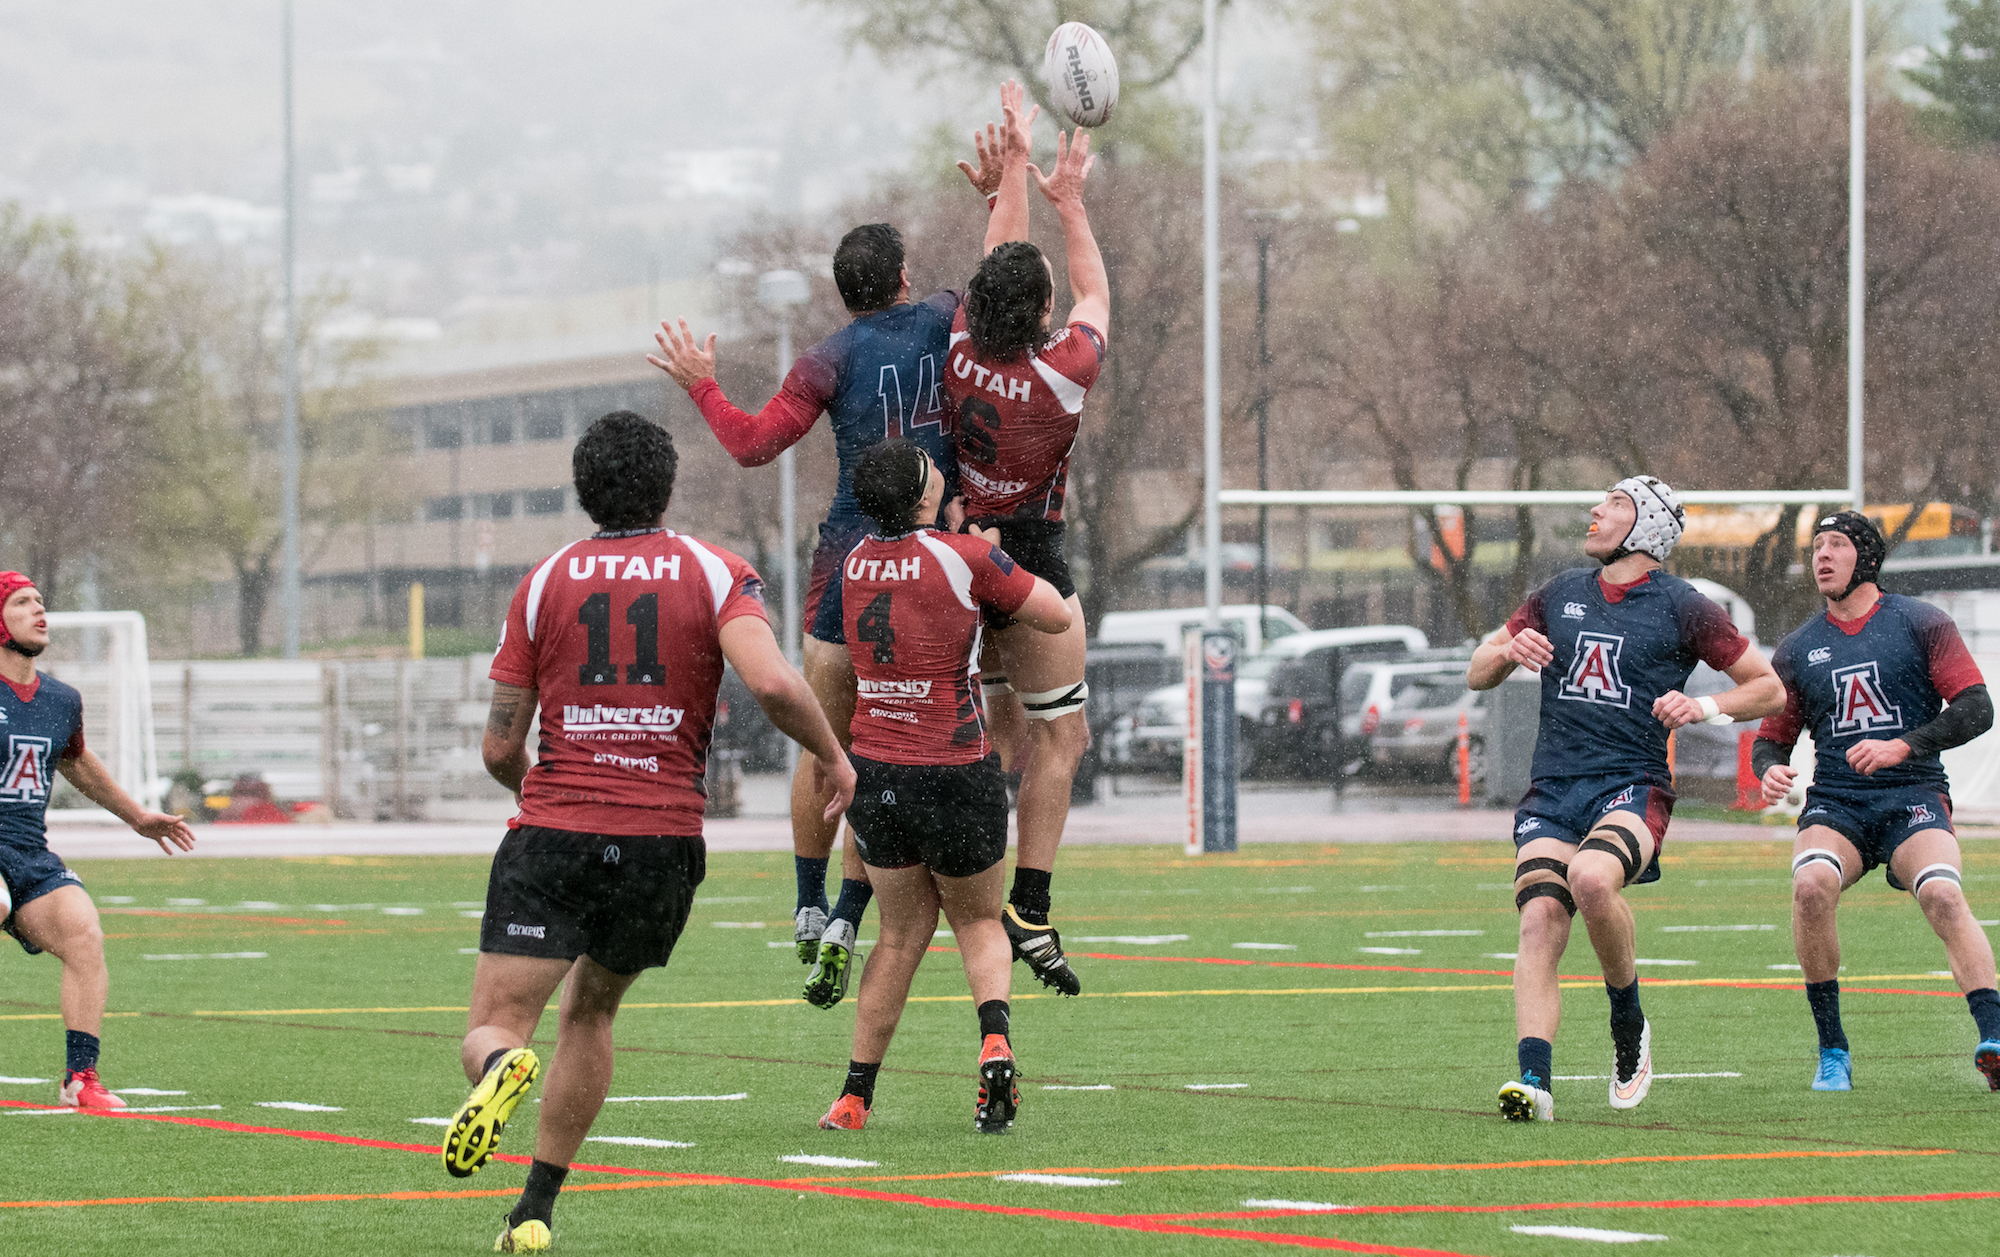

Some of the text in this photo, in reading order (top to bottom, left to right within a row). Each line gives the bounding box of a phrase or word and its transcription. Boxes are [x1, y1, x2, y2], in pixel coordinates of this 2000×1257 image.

[1065, 45, 1095, 111] RHINO
[878, 353, 951, 439] 14
[952, 351, 1032, 403] UTAH
[568, 554, 682, 581] UTAH
[846, 556, 921, 582] UTAH
[577, 592, 667, 686] 11
[856, 592, 896, 665] 4
[1557, 630, 1632, 710] A
[1830, 660, 1904, 738] A
[562, 703, 686, 733] University
[564, 732, 608, 741] FEDERAL
[611, 732, 648, 740] CREDIT
[0, 734, 52, 803] A
[593, 752, 659, 774] OLYMPUS
[506, 922, 546, 939] OLYMPUS
